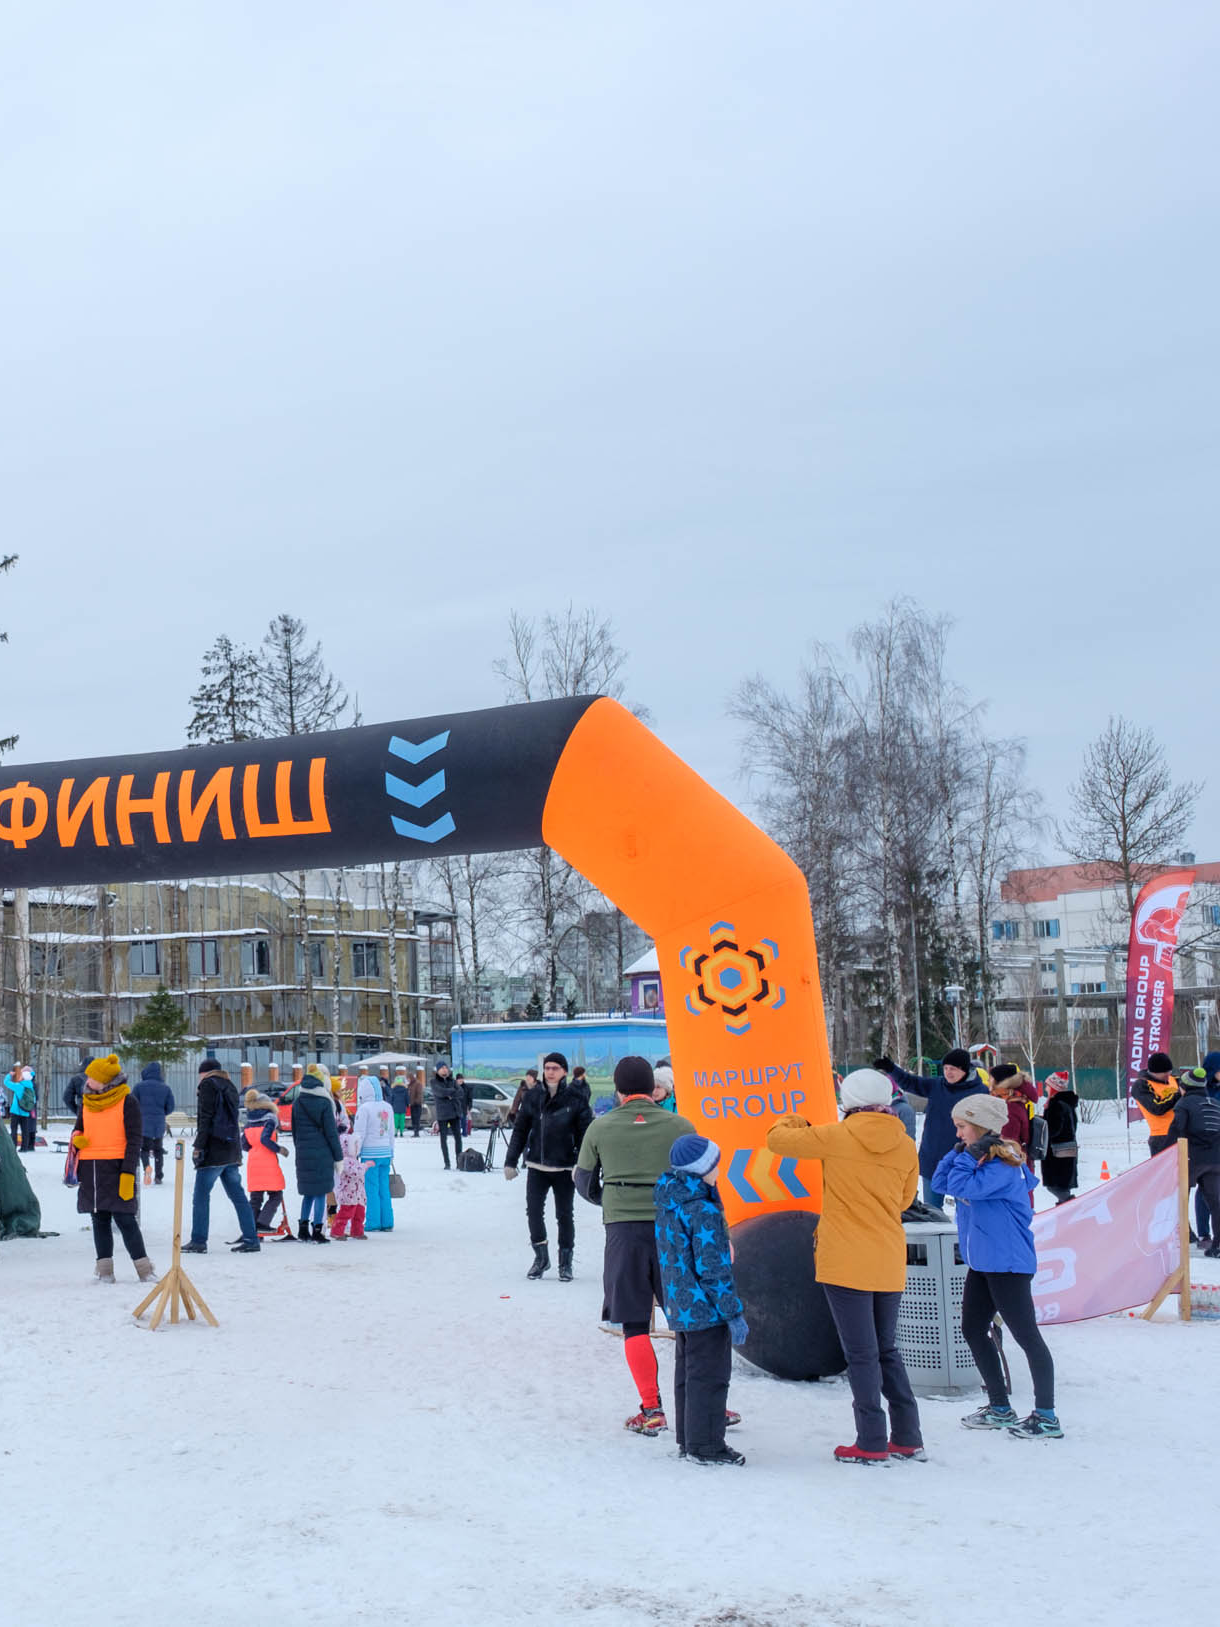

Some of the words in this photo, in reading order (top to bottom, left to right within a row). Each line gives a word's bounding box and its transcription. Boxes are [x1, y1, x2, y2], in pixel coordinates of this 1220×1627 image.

[1134, 955, 1150, 1020] GROUP
[1148, 980, 1165, 1052] STRONGER
[693, 1062, 805, 1088] МАРШРУТ
[700, 1089, 806, 1119] GROUP
